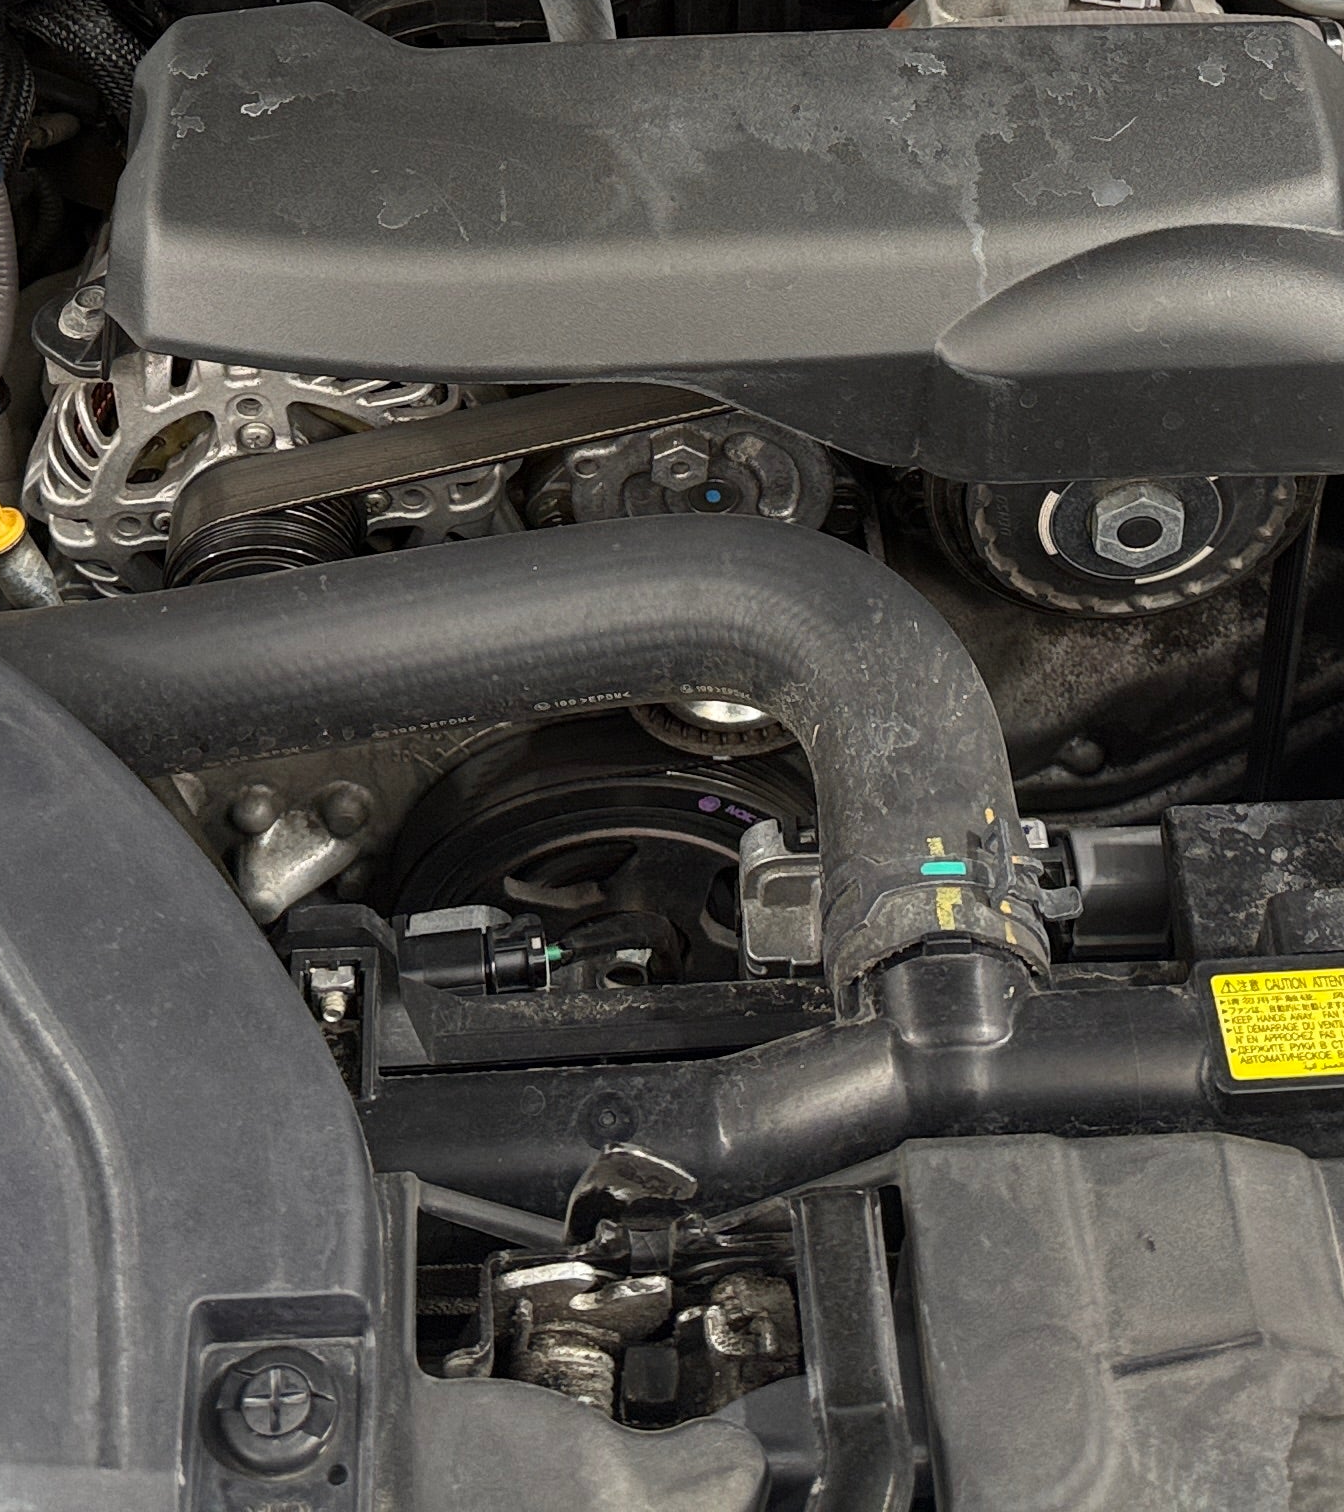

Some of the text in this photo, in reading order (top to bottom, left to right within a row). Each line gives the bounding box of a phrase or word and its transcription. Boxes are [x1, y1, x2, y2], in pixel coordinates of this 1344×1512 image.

[1265, 978, 1308, 991] CAUTION
[1231, 1014, 1255, 1025] KEEP
[1256, 1012, 1286, 1024] HANDS
[1322, 1009, 1340, 1020] FAN
[1233, 1024, 1245, 1035] LE
[1302, 1020, 1316, 1031] DU
[1319, 1028, 1337, 1040] PAS
